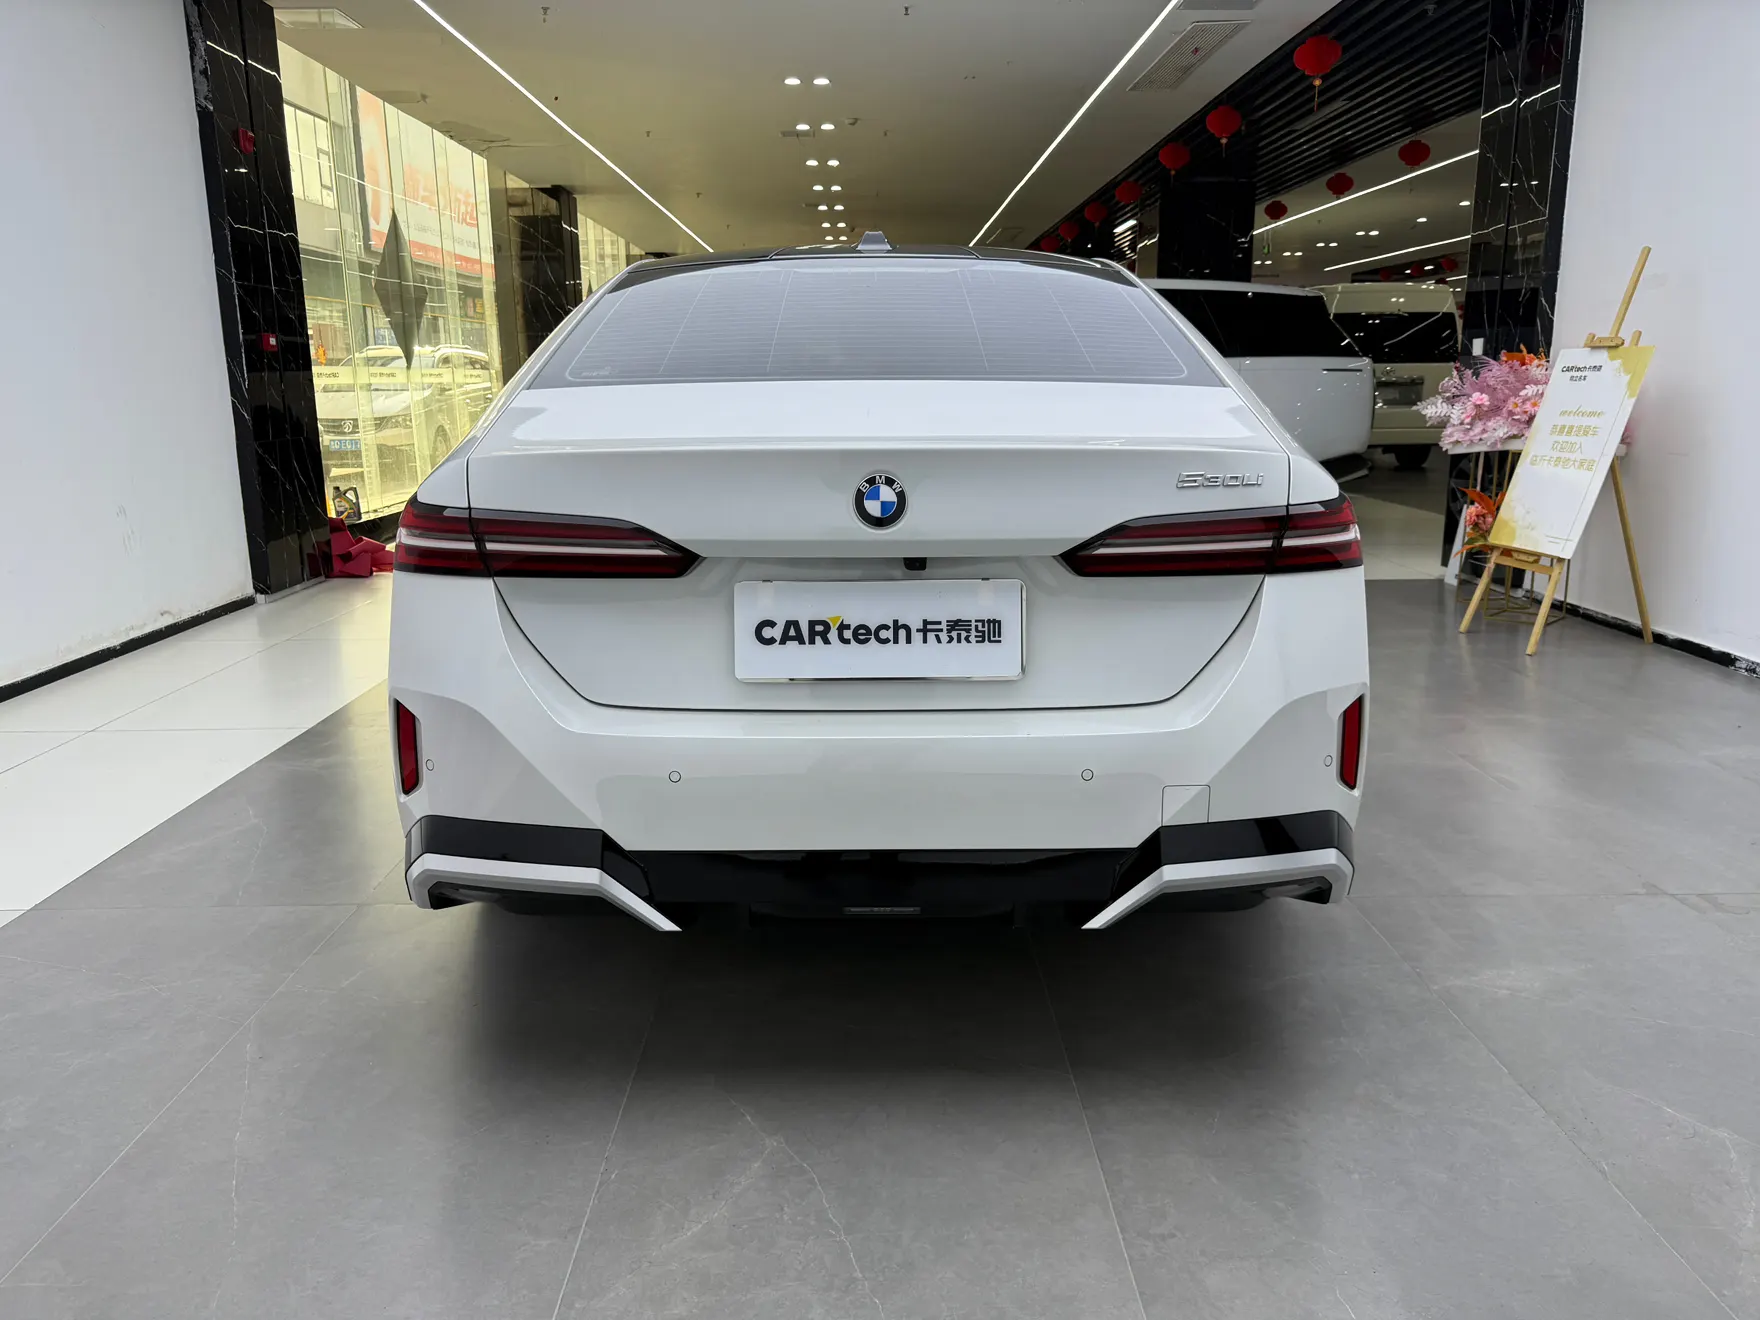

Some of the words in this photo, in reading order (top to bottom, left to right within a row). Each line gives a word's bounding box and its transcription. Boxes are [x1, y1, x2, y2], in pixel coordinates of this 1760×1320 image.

[1559, 404, 1606, 418] welcome
[1550, 440, 1583, 455] 欢迎加入
[859, 475, 903, 493] BMW
[1176, 471, 1264, 489] 530Li
[754, 617, 912, 646] CARtech
[915, 618, 1003, 645] 卡泰驰
